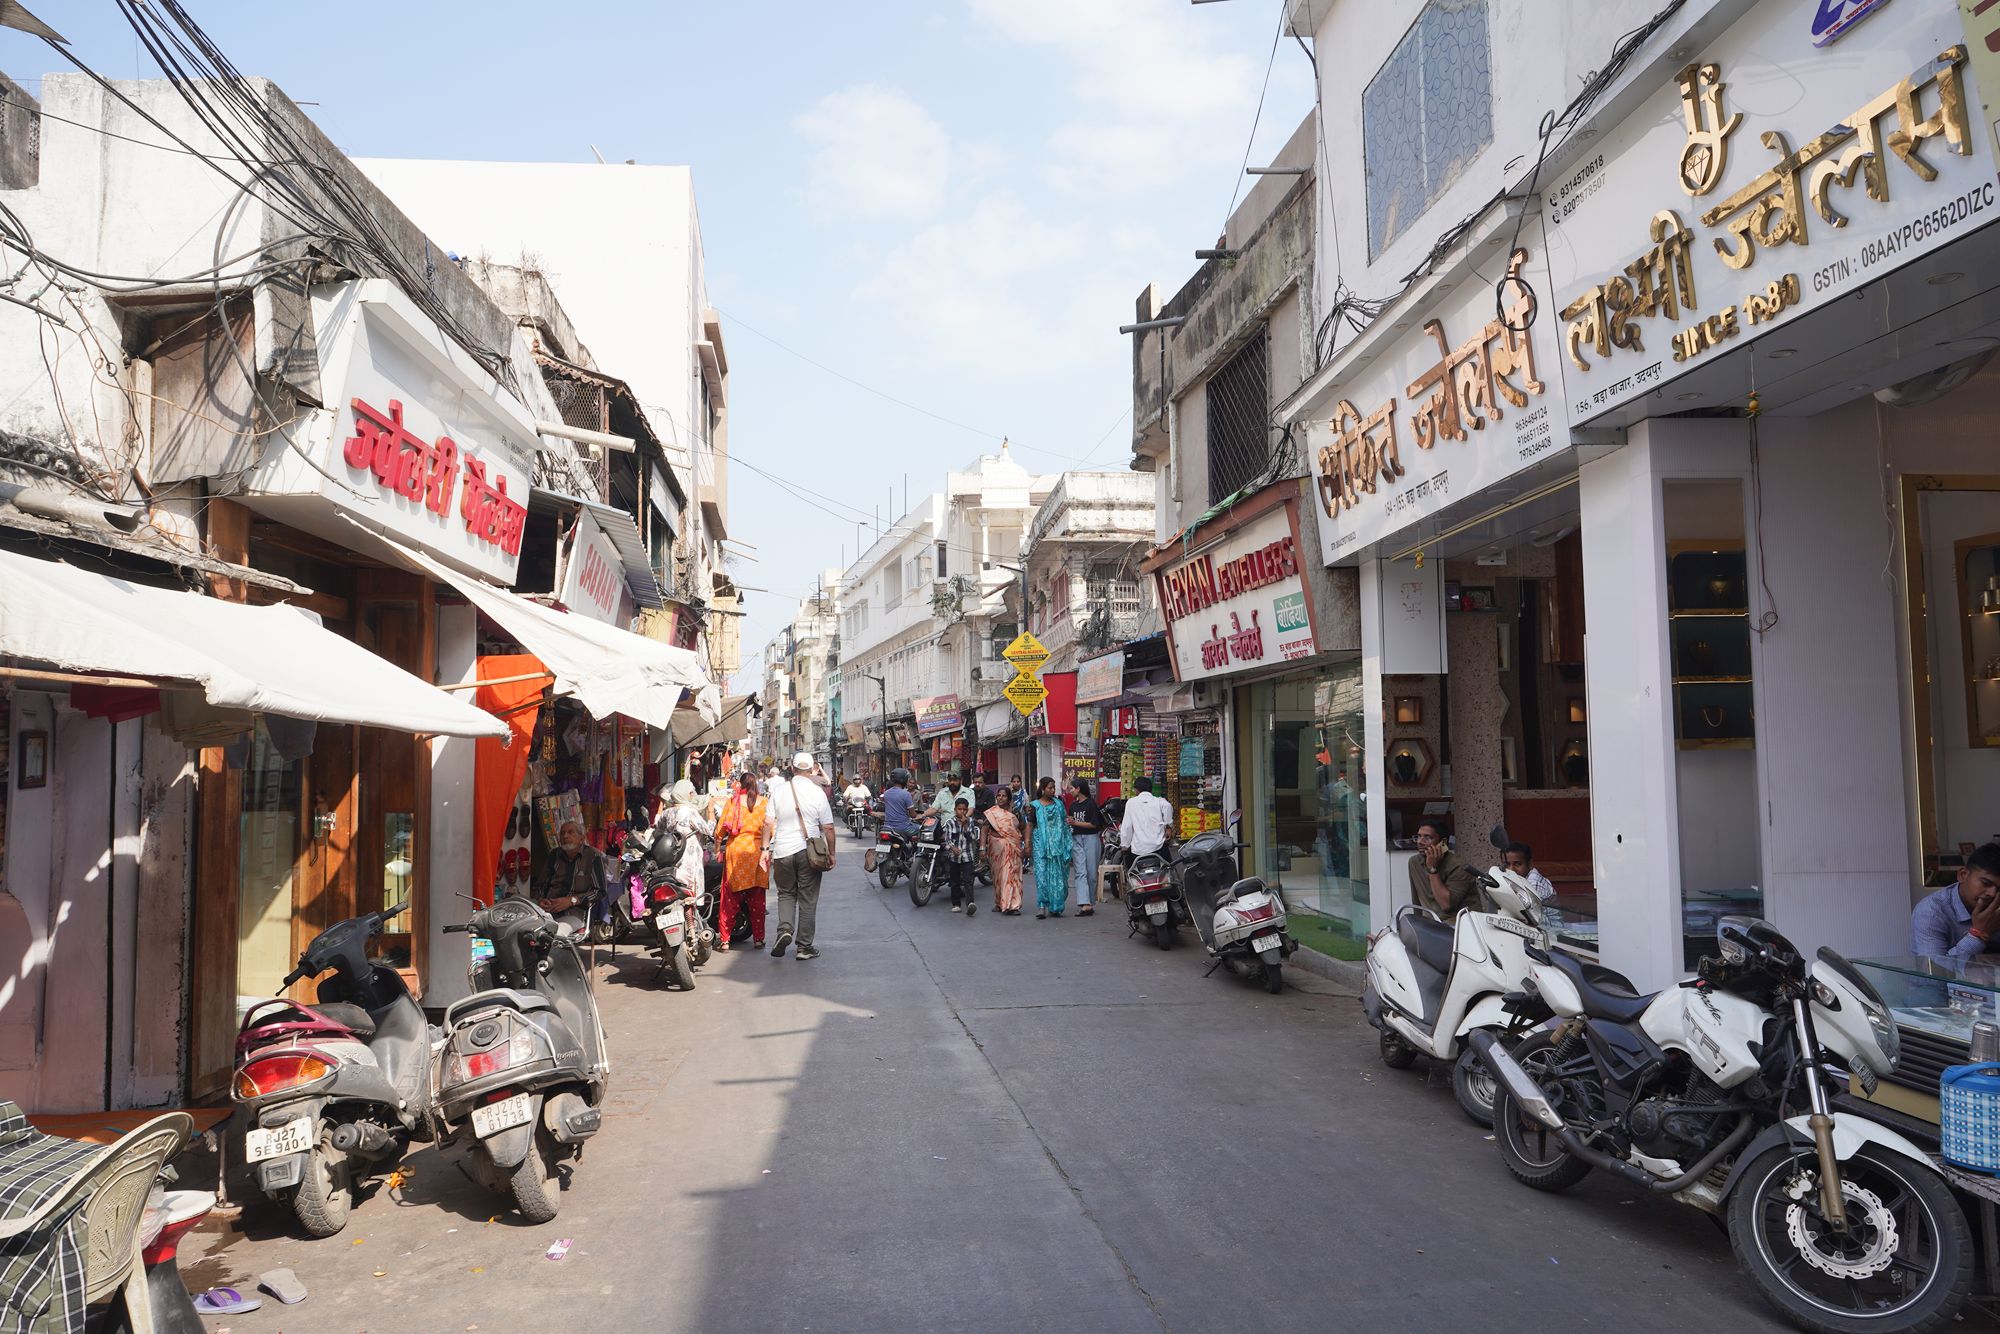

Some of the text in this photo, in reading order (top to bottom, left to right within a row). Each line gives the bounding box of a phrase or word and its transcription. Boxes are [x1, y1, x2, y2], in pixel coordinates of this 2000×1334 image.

[1560, 154, 1604, 198] 9314570618
[1813, 256, 1850, 292] GSTIN
[1671, 273, 1800, 362] SINCE 1980
[1162, 536, 1299, 622] ARYAN JEWELLERS
[1064, 756, 1096, 771] नाकोड़ा
[255, 1145, 271, 1157] SE
[266, 1127, 296, 1144] RJ27
